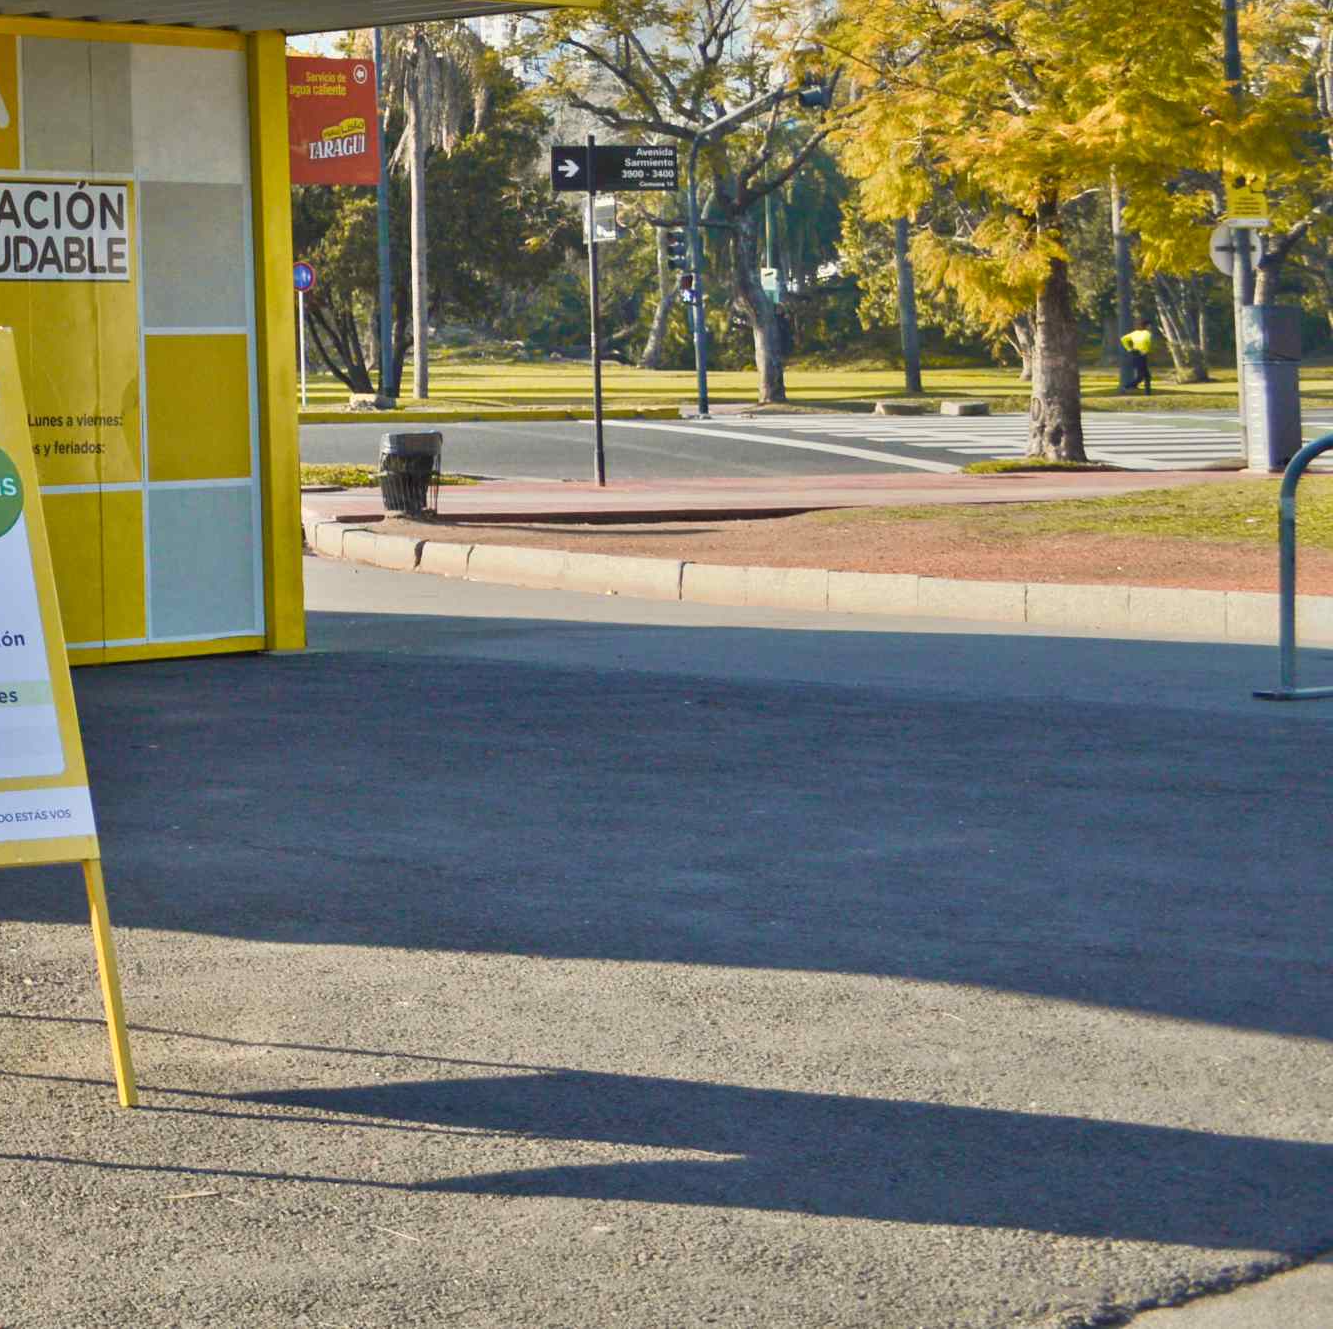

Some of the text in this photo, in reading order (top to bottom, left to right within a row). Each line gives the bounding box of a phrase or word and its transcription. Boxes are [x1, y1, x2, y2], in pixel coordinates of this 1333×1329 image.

[636, 147, 674, 156] Avenida
[624, 157, 674, 167] Sarmiento
[28, 413, 123, 427] Lunes a viernes:
[44, 444, 52, 457] y
[54, 440, 105, 455] feriados:
[49, 808, 71, 819] VOS
